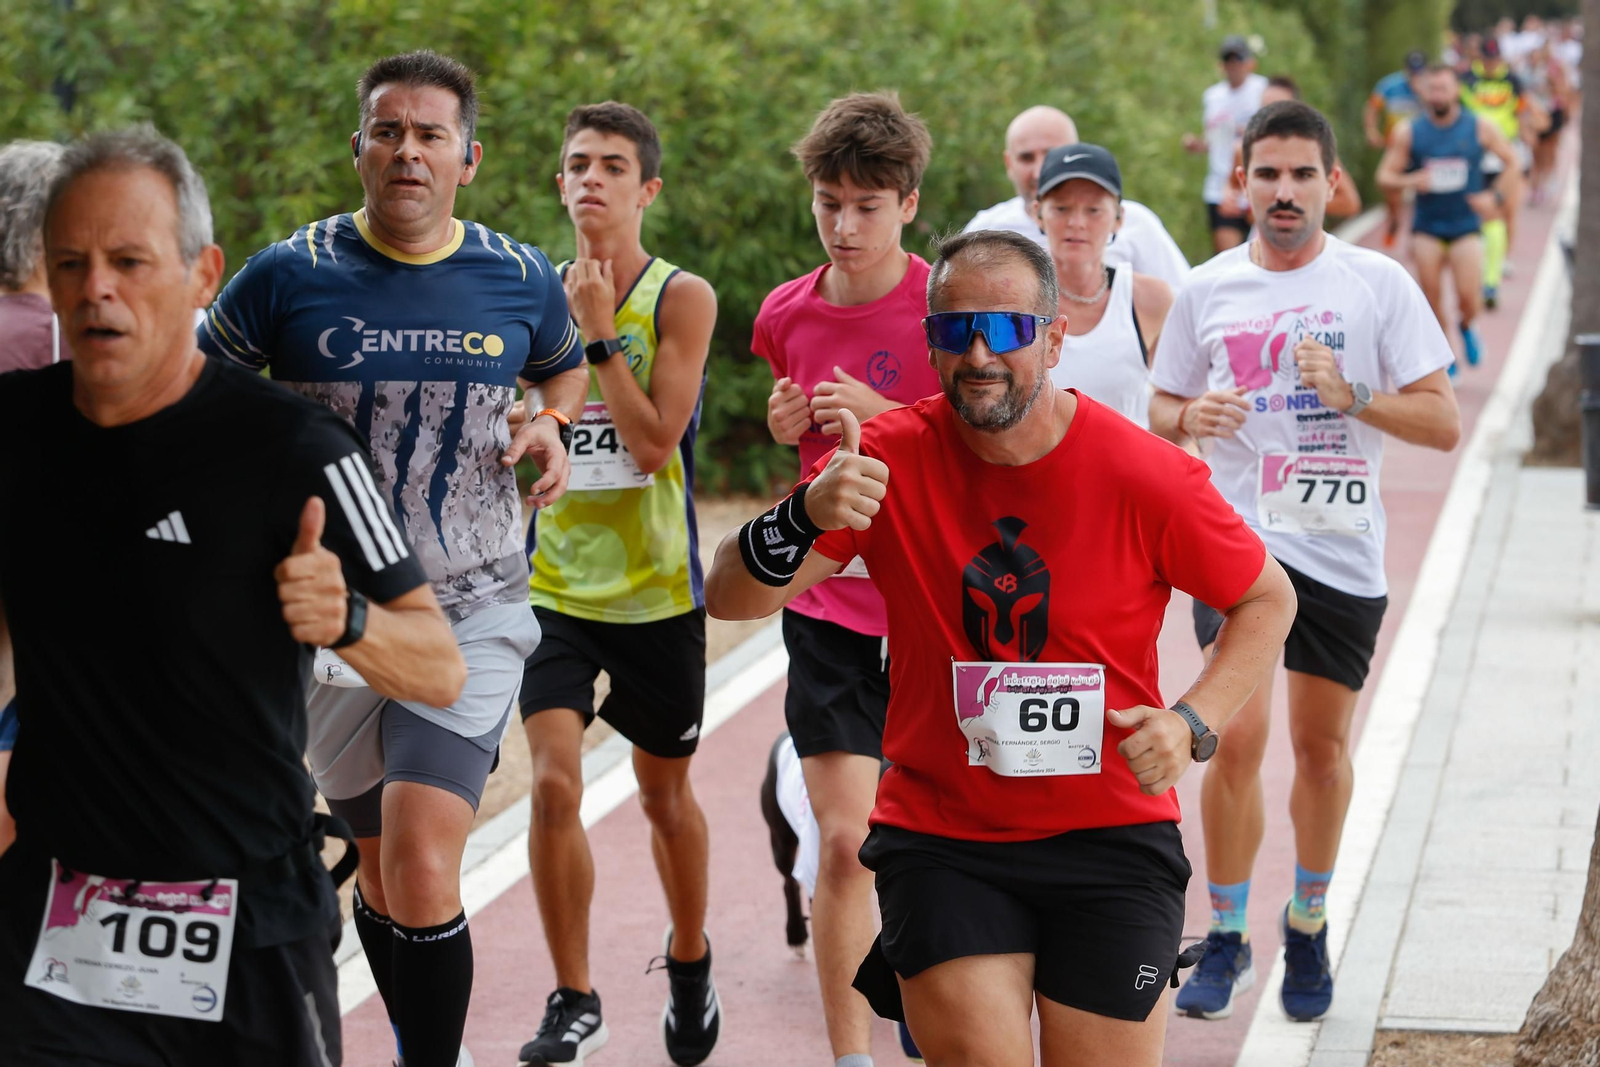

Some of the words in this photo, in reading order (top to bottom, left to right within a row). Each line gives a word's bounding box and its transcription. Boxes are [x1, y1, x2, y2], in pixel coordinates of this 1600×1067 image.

[424, 356, 502, 369] COMMUNITY
[573, 427, 630, 456] 24
[1297, 479, 1366, 504] 770
[1019, 697, 1080, 732] 60
[99, 912, 220, 964] 109
